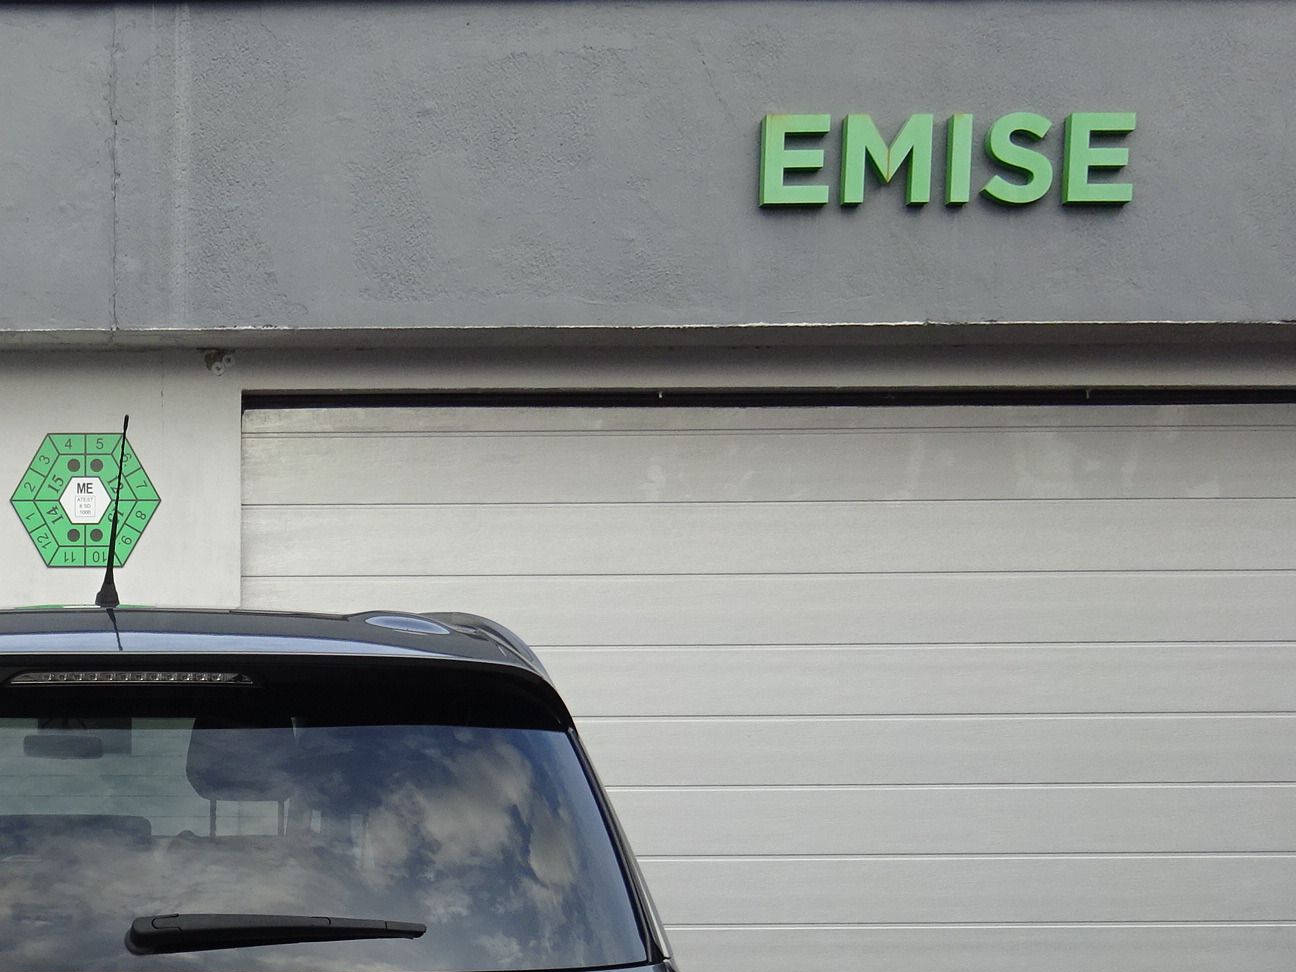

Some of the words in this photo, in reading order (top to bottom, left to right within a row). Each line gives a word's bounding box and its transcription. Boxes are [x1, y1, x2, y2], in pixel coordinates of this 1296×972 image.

[759, 111, 1137, 208] EMISE
[65, 438, 72, 449] 4
[96, 438, 104, 449] 5
[38, 455, 51, 465] 3
[24, 481, 36, 493] 2
[48, 474, 64, 494] 15
[76, 482, 94, 495] ME
[135, 480, 148, 489] 7
[25, 511, 36, 521] 1
[46, 506, 64, 524] 14
[135, 510, 147, 520] 8
[37, 532, 52, 550] 12
[64, 551, 76, 563] 11
